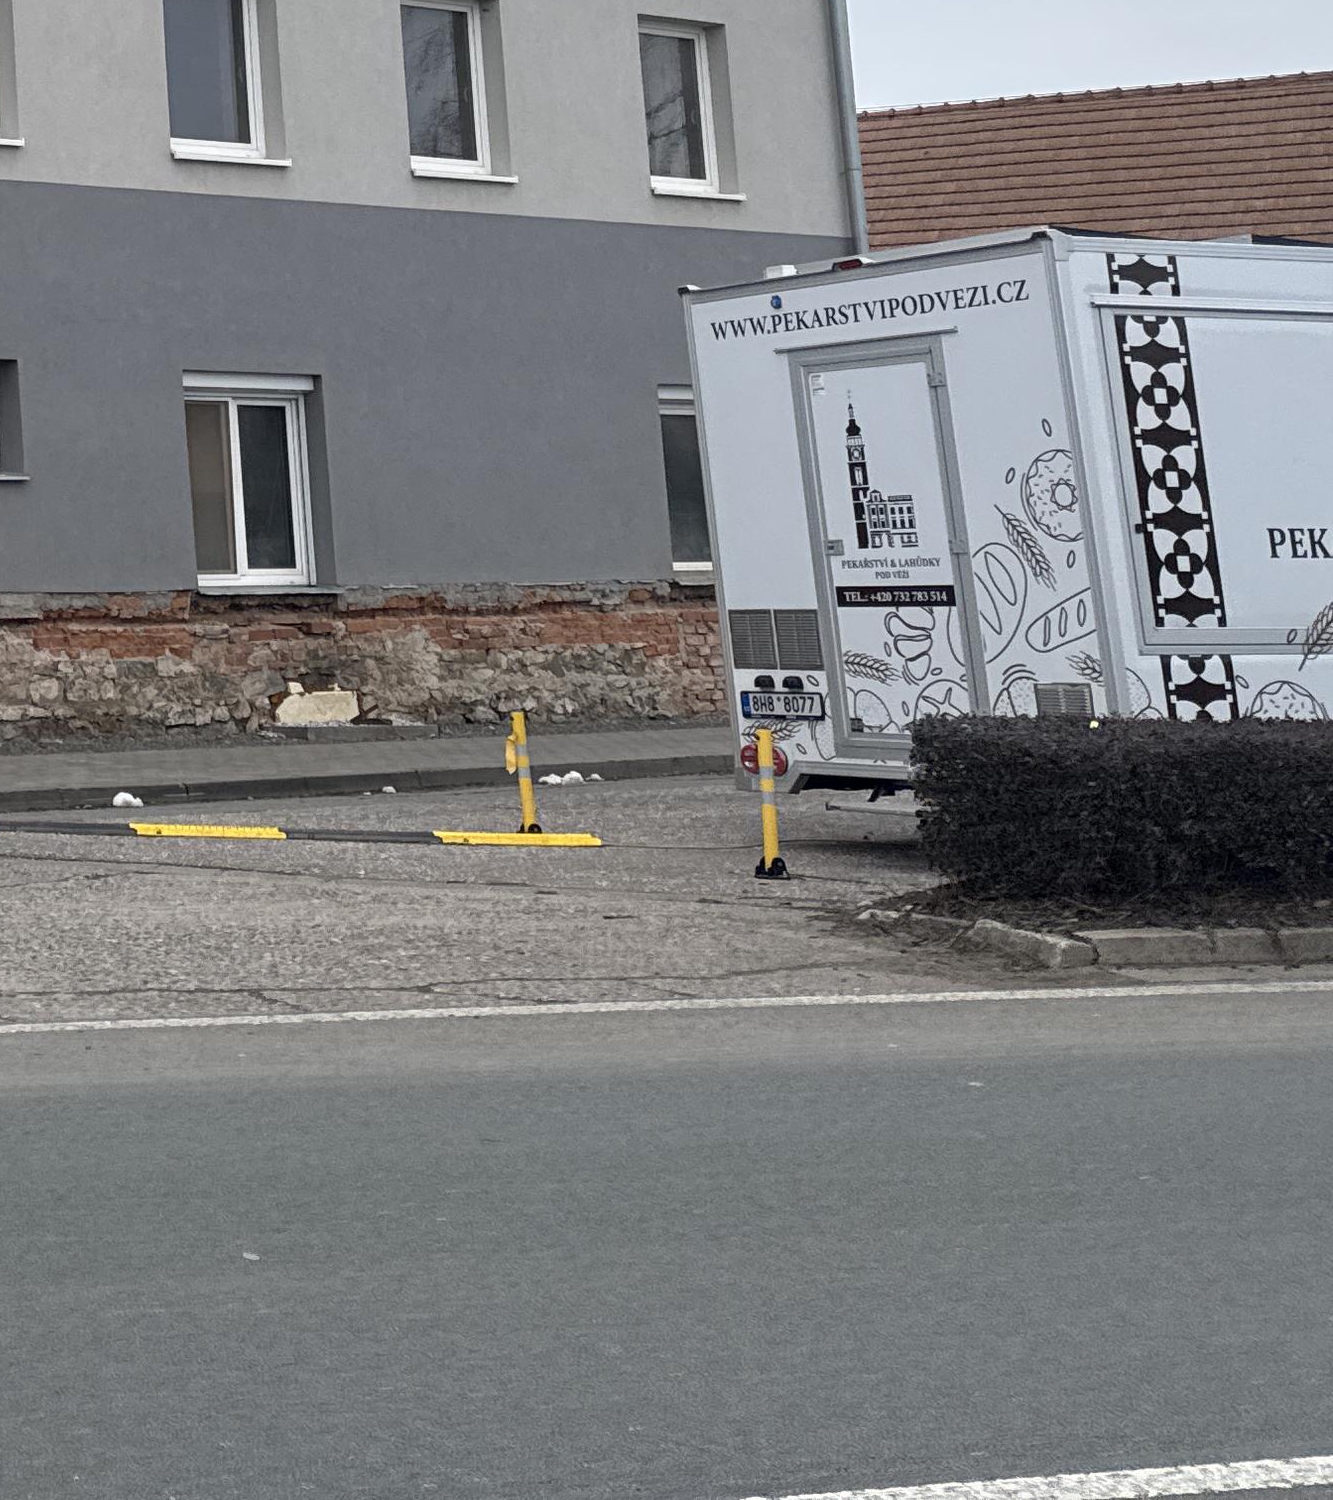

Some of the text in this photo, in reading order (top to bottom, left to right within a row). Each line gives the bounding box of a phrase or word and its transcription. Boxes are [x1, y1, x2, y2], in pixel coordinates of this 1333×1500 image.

[710, 279, 1030, 341] WWW.PEKARSTVIPODVEZI.CZ
[1266, 527, 1333, 559] PEK
[842, 556, 941, 569] PEKAŘSTVÍ & LAHŮDKY
[875, 571, 891, 579] POD
[870, 591, 892, 602] +420
[893, 592, 911, 602] 732
[912, 591, 929, 601] 783
[930, 591, 947, 601] 514
[753, 695, 775, 712] 8H8
[783, 696, 815, 713] 8077
